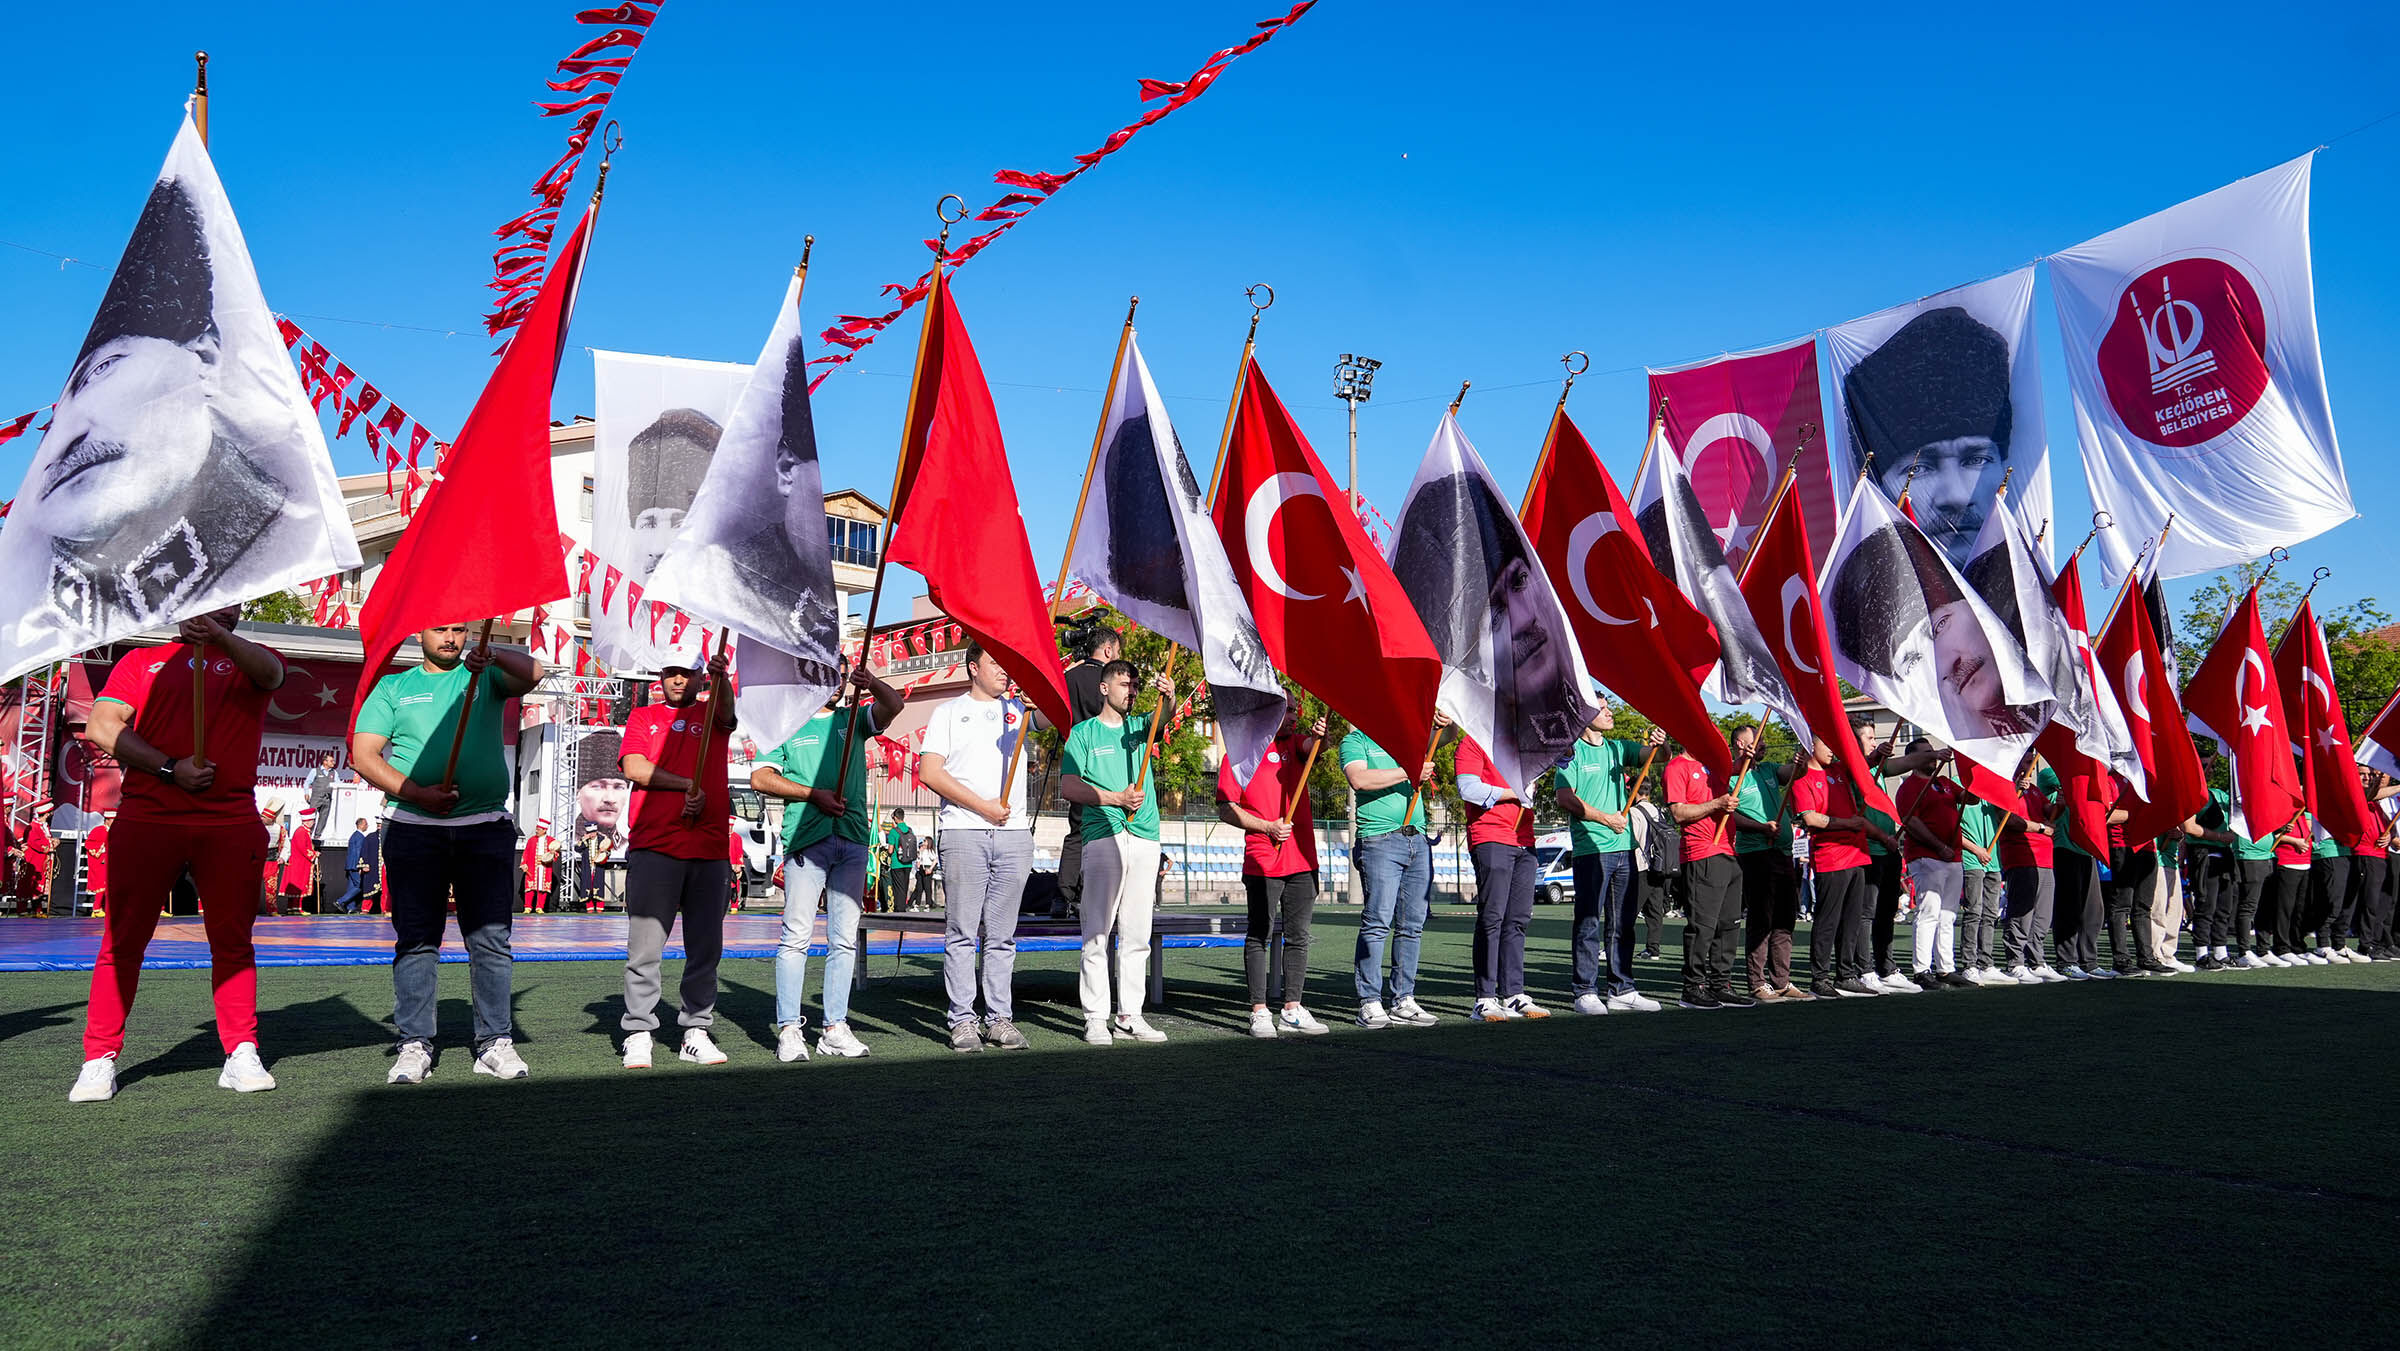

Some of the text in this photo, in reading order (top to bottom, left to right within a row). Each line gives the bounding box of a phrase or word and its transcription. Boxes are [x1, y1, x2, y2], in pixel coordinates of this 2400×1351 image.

[2175, 383, 2196, 397] T.C.
[2155, 387, 2228, 423] KEÇİÖREN
[2160, 400, 2233, 437] BELEDİYESİ
[260, 744, 341, 770] ATATÜRKÜ
[256, 774, 293, 789] GENÇLİK
